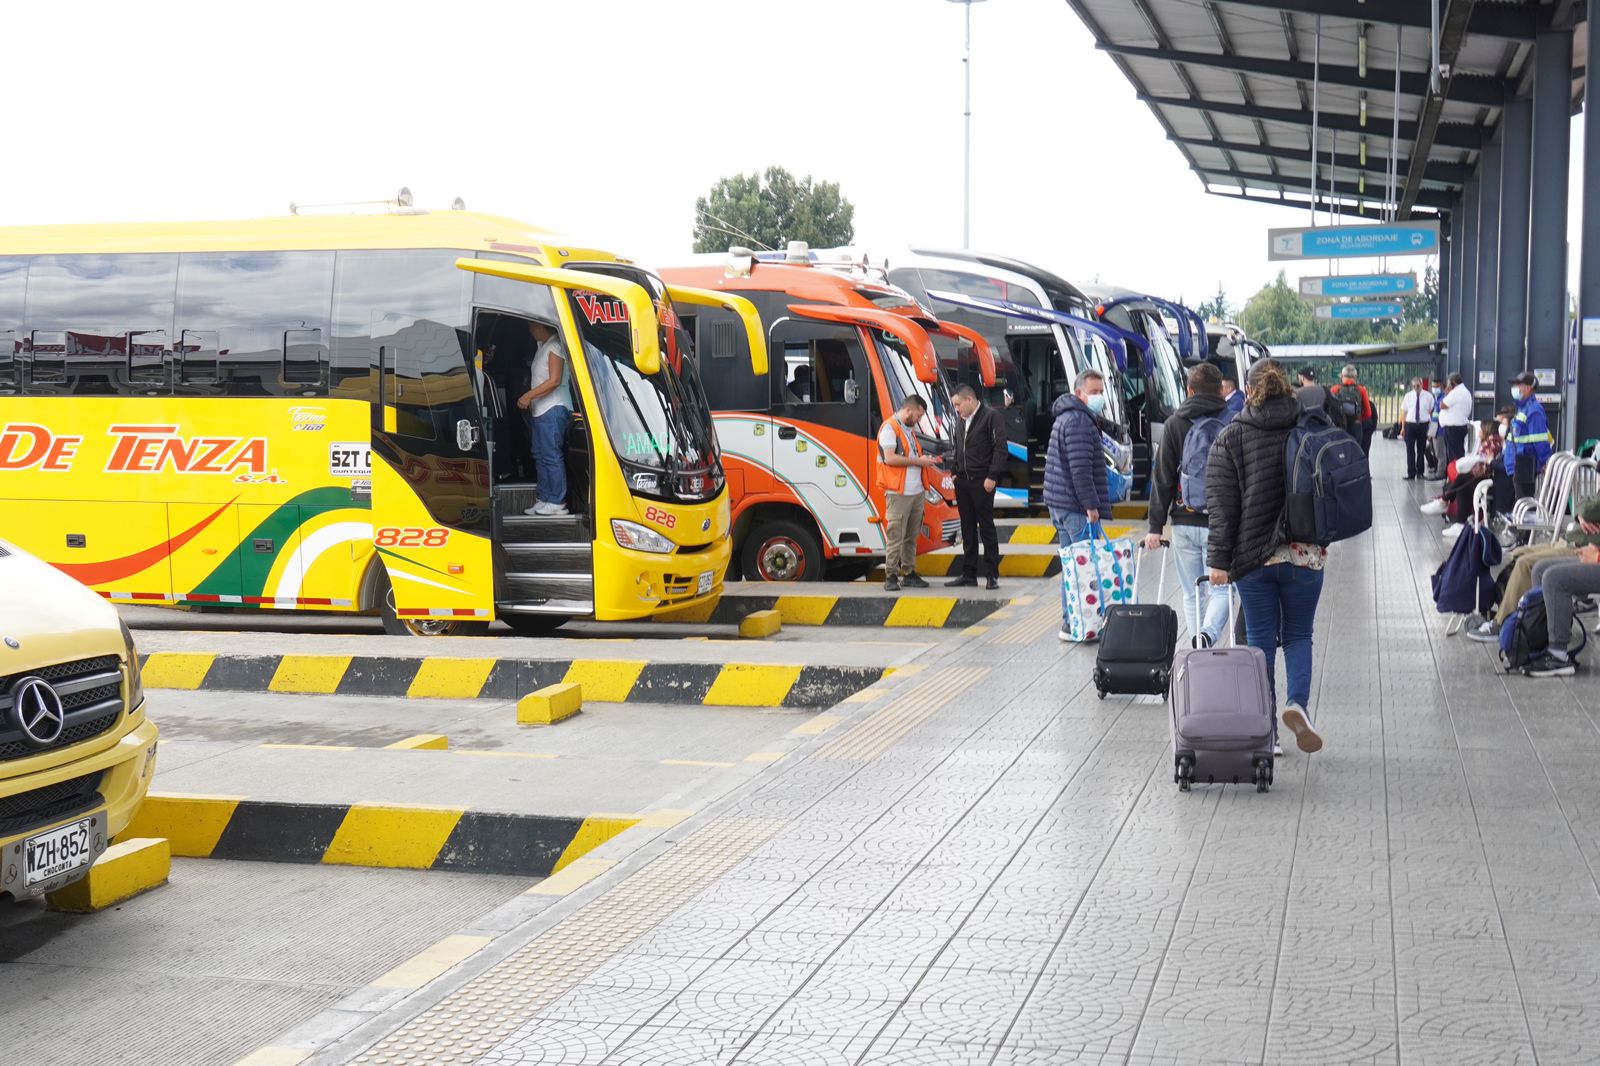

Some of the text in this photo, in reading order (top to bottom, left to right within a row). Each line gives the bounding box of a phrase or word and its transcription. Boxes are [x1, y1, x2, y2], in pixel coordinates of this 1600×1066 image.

[1356, 233, 1398, 242] ABORDAJE
[103, 424, 268, 474] TENZA
[331, 450, 360, 468] SZT
[645, 506, 676, 529] 828
[374, 527, 449, 547] 828
